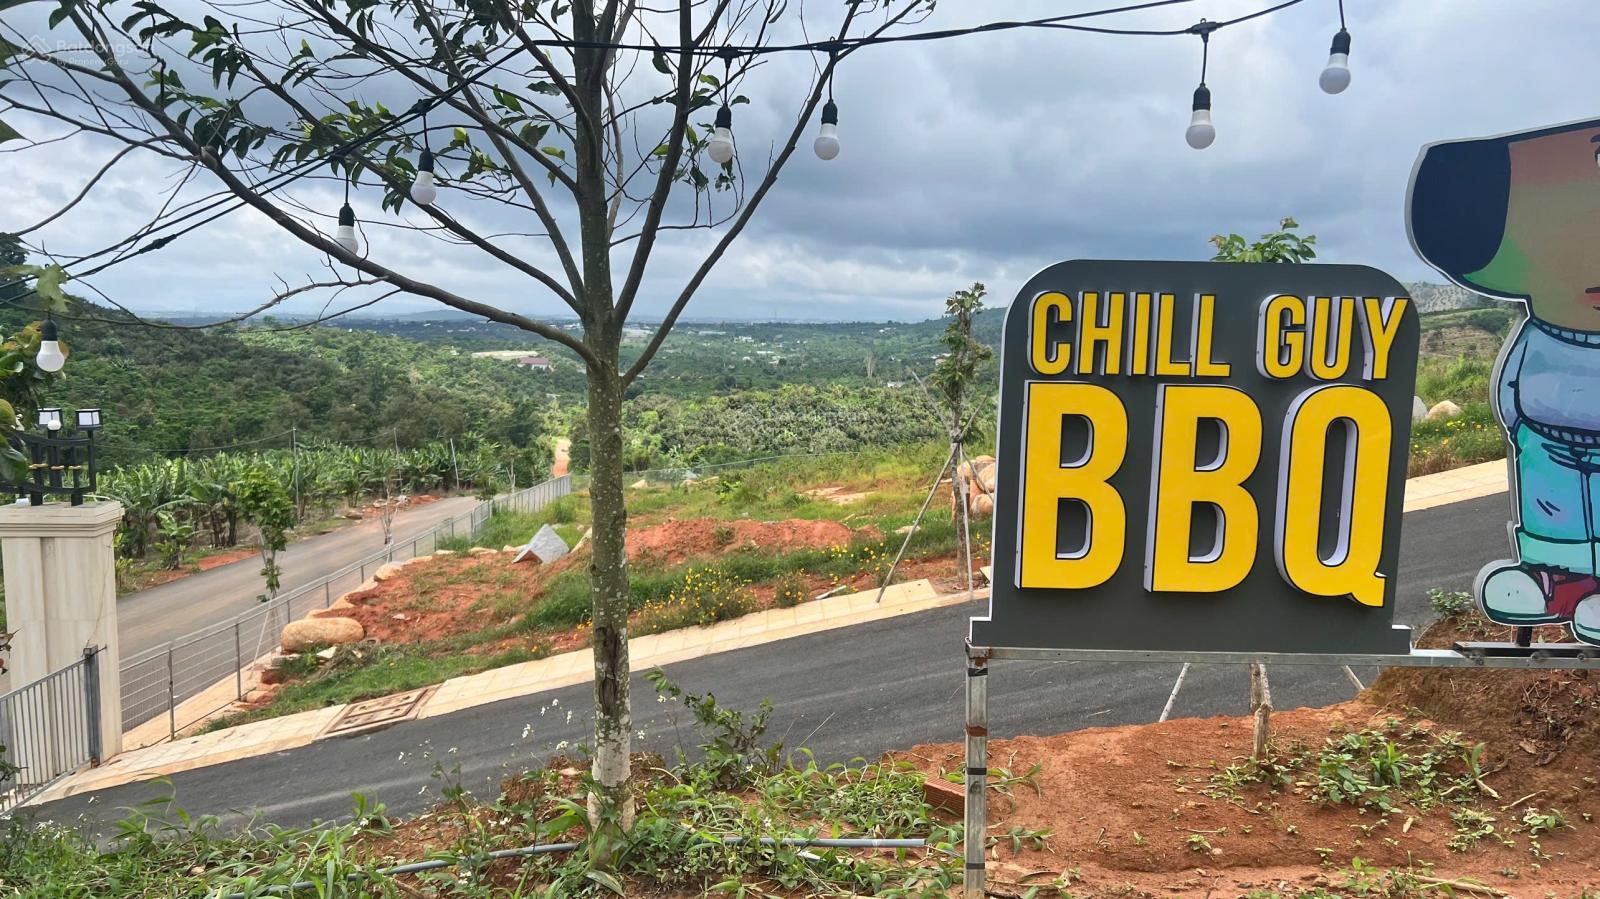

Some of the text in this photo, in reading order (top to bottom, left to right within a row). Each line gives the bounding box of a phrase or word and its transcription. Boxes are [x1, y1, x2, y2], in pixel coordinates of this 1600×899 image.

[1028, 291, 1408, 380] CHILL GUY
[1015, 380, 1393, 607] BBQ
